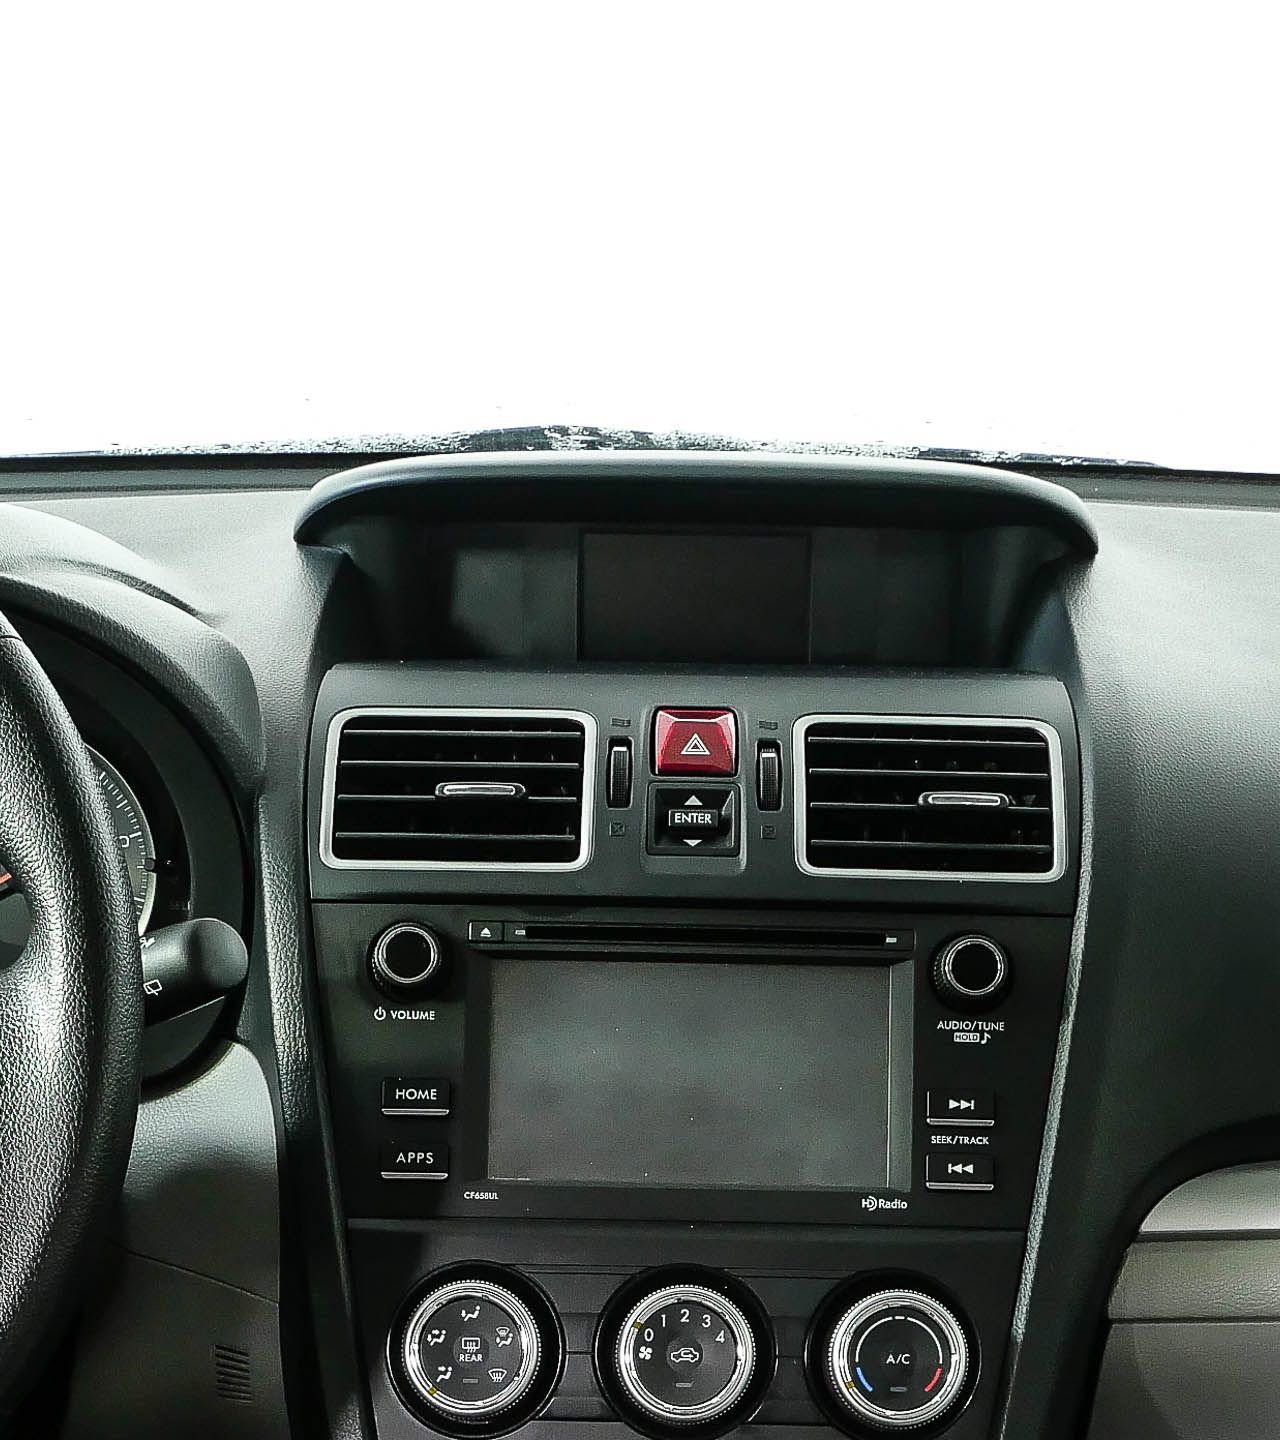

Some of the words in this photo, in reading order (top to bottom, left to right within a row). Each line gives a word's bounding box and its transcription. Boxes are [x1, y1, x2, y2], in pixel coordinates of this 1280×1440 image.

[674, 812, 712, 824] ENTER
[390, 1010, 436, 1020] VOLUME
[937, 1020, 1005, 1032] AUDIO/TUNE
[954, 1032, 980, 1043] HOLD
[395, 1089, 438, 1100] HOME
[931, 1136, 990, 1145] SEEK/TRACK
[396, 1152, 434, 1164] APPS
[464, 1191, 499, 1200] CF658UL
[878, 1198, 908, 1210] Radio
[661, 1314, 667, 1328] 1
[680, 1308, 690, 1323] 2
[701, 1314, 711, 1328] 3
[644, 1328, 654, 1342] 0
[715, 1329, 725, 1343] 4
[459, 1353, 483, 1362] REAR
[886, 1353, 911, 1365] A/C
